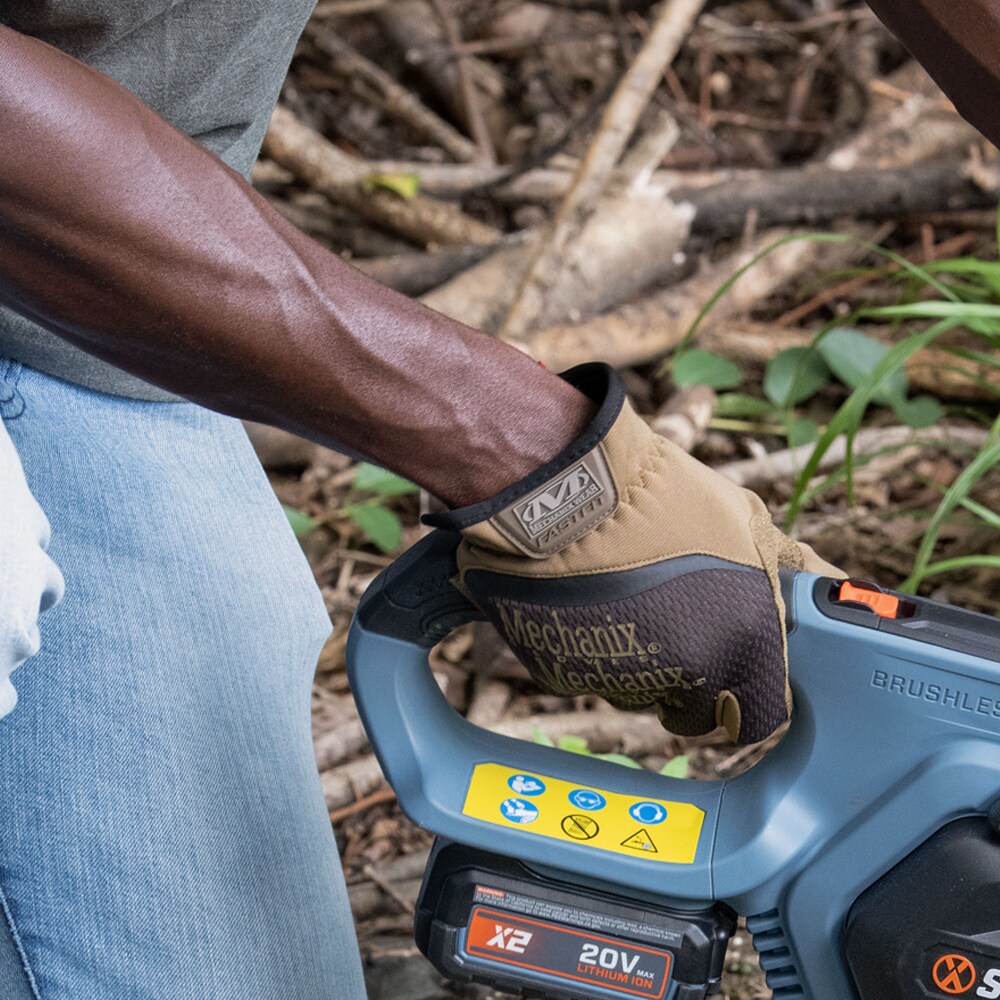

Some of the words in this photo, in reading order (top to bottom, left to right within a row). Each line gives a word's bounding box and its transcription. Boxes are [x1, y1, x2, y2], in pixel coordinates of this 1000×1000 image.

[574, 483, 600, 506] WEAR
[486, 925, 533, 954] X2
[579, 943, 640, 974] 20V
[636, 969, 655, 980] MAX
[577, 963, 628, 984] LITHIUM
[631, 977, 653, 989] ION
